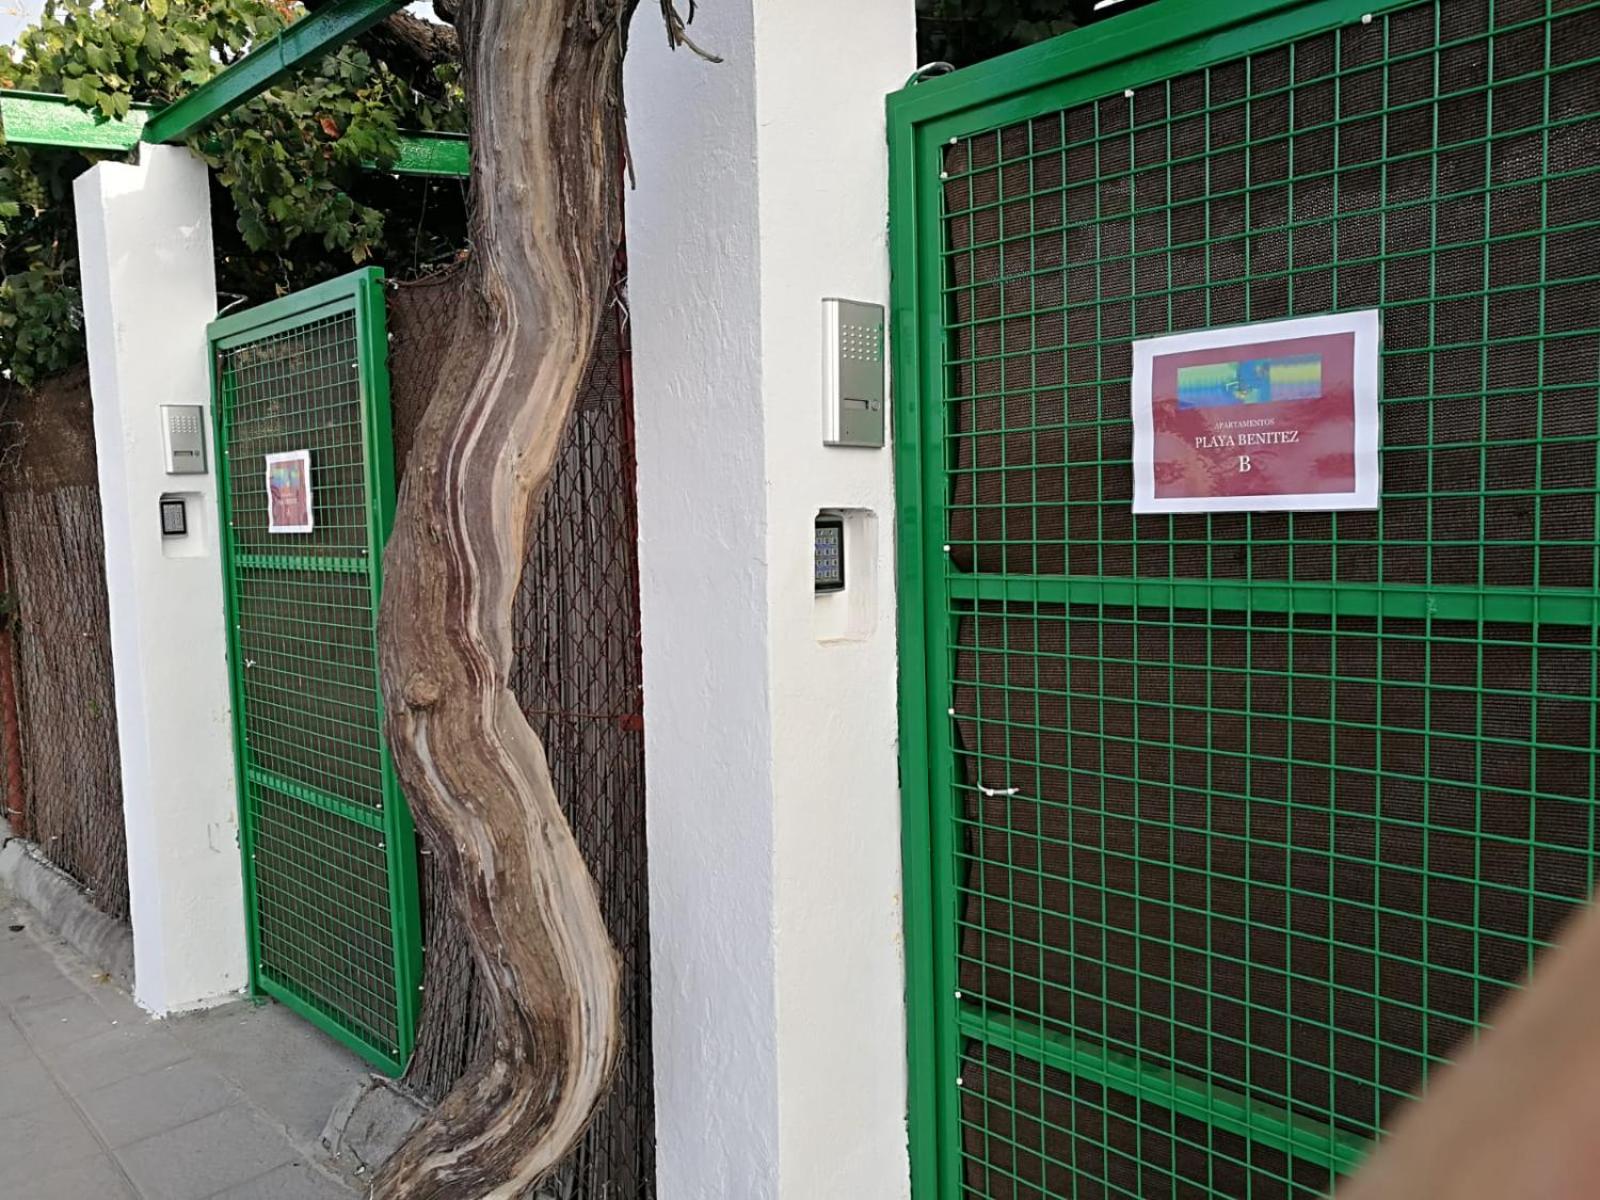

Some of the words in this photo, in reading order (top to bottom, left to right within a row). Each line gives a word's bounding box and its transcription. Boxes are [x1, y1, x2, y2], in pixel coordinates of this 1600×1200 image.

[1214, 418, 1275, 430] APARTAMENTOS
[1195, 434, 1235, 449] PLAYA
[1238, 430, 1299, 446] BENITEZ
[1239, 455, 1252, 472] B
